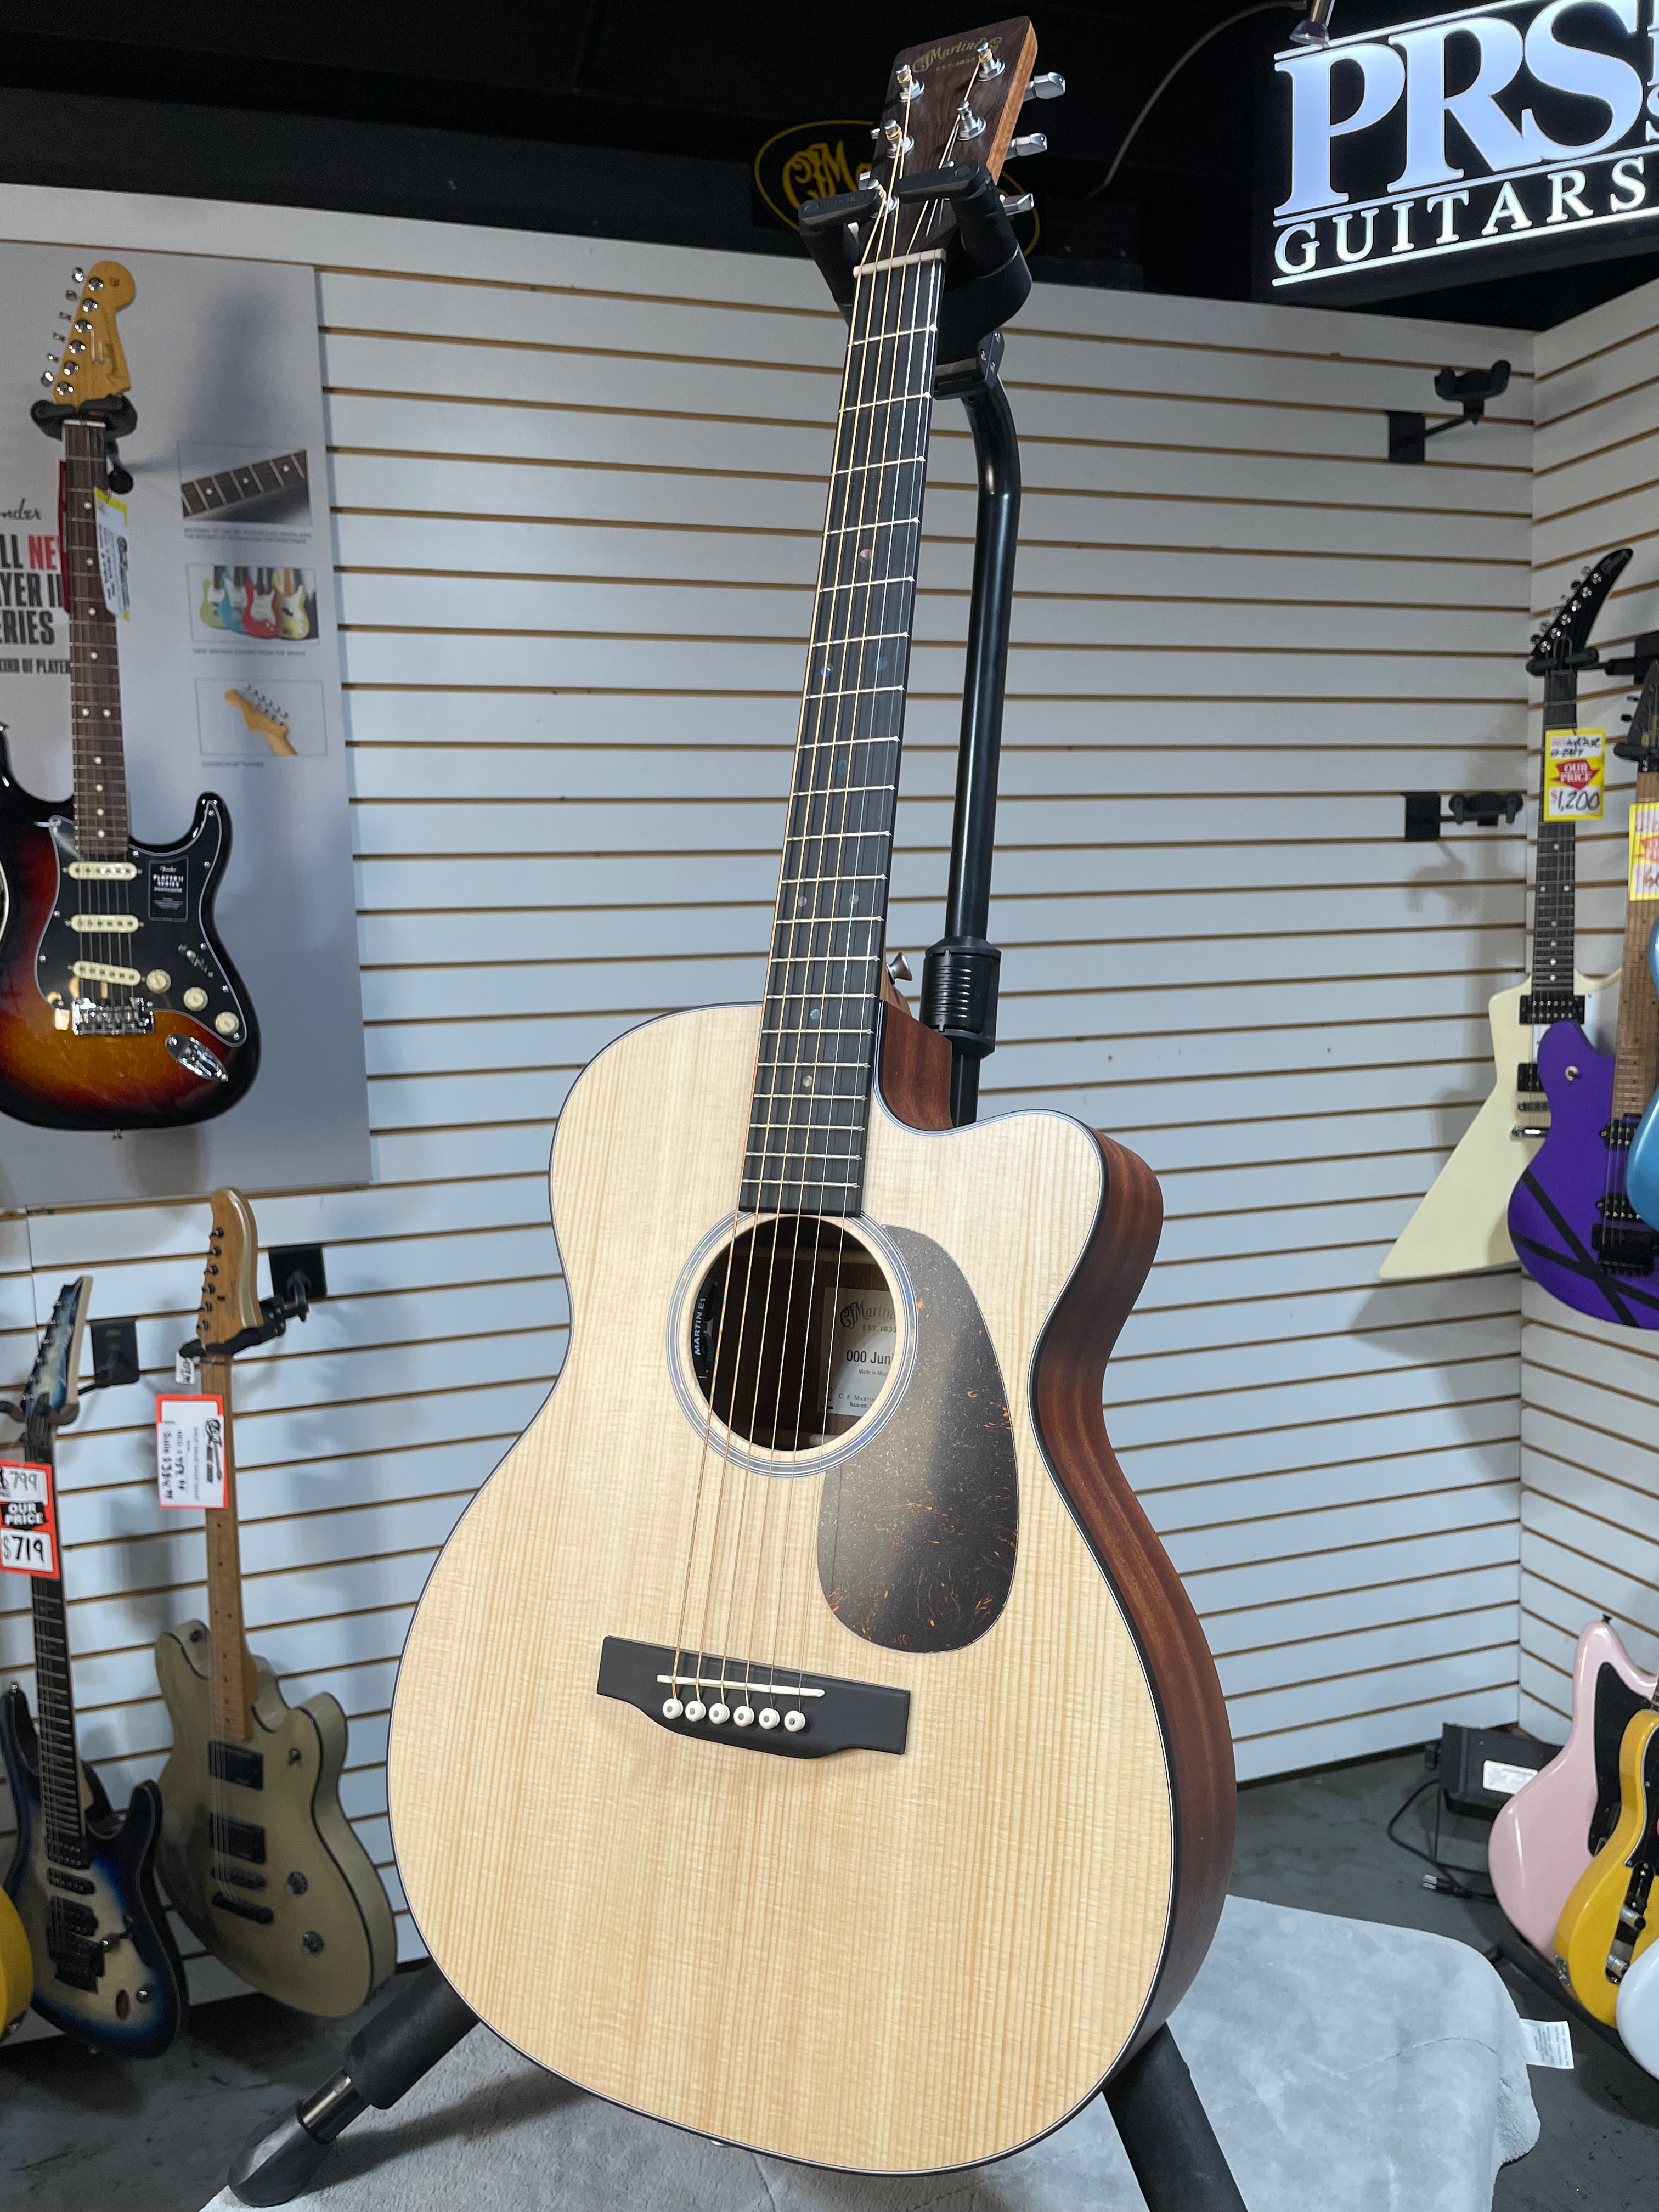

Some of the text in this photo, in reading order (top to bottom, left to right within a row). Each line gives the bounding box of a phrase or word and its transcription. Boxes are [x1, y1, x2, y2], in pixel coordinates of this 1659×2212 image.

[1274, 0, 1643, 216] PRS
[1274, 156, 1646, 274] GUITARS
[28, 535, 59, 569] NE
[0, 610, 54, 645] RIES
[694, 1297, 707, 1355] MARTIN E1
[847, 1350, 867, 1363] 000
[4, 1512, 44, 1526] PRICE
[8, 1502, 37, 1515] OUR
[3, 1534, 44, 1562] $719
